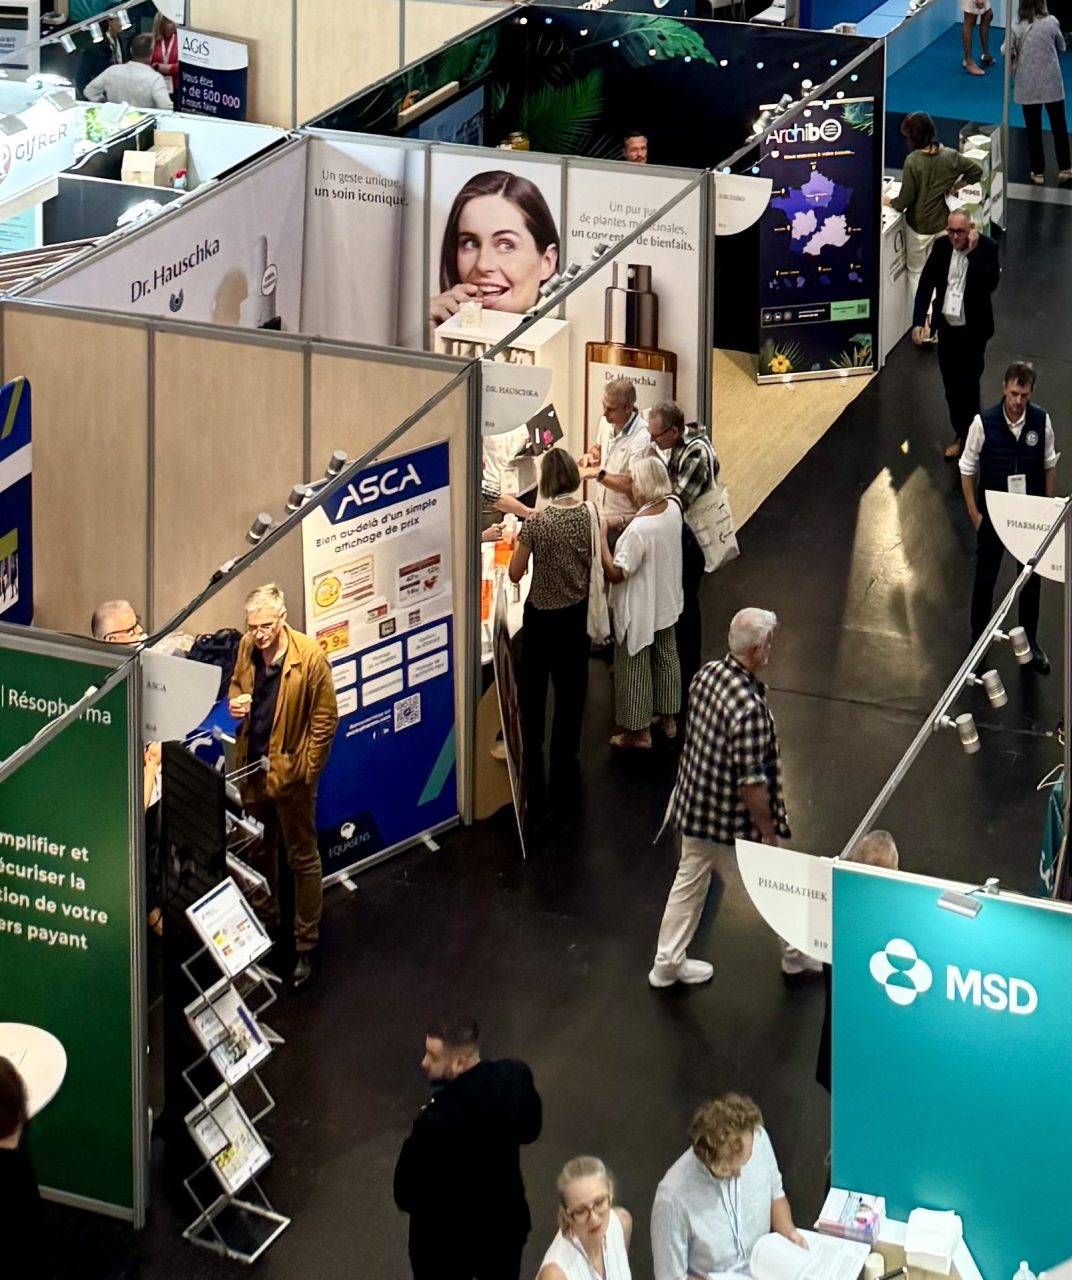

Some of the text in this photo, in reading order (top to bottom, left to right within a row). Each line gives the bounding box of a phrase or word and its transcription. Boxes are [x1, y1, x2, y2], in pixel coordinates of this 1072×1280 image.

[188, 86, 201, 98] de
[203, 89, 220, 103] 600
[222, 94, 240, 109] 000
[322, 170, 336, 181] Un
[338, 171, 364, 184] geste
[314, 186, 329, 198] un
[332, 187, 355, 200] soin
[609, 201, 623, 213] Un
[625, 204, 642, 215] pur
[579, 213, 590, 223] de
[593, 214, 627, 228] plantes
[571, 229, 584, 238] un
[636, 234, 649, 246] de
[650, 235, 695, 252] bienfaits.
[131, 238, 221, 304] Dr. Hauschka
[335, 463, 422, 520] ASCA
[340, 519, 379, 538] au-delà
[381, 510, 403, 524] d'un
[405, 498, 438, 516] simple
[334, 517, 420, 553] affichage de prix
[71, 846, 90, 862] et
[70, 872, 86, 891] la
[758, 876, 828, 902] PHARMATHEK
[35, 895, 57, 914] de
[61, 902, 109, 925] votre
[27, 923, 88, 950] payant
[945, 963, 1039, 1015] MSD
